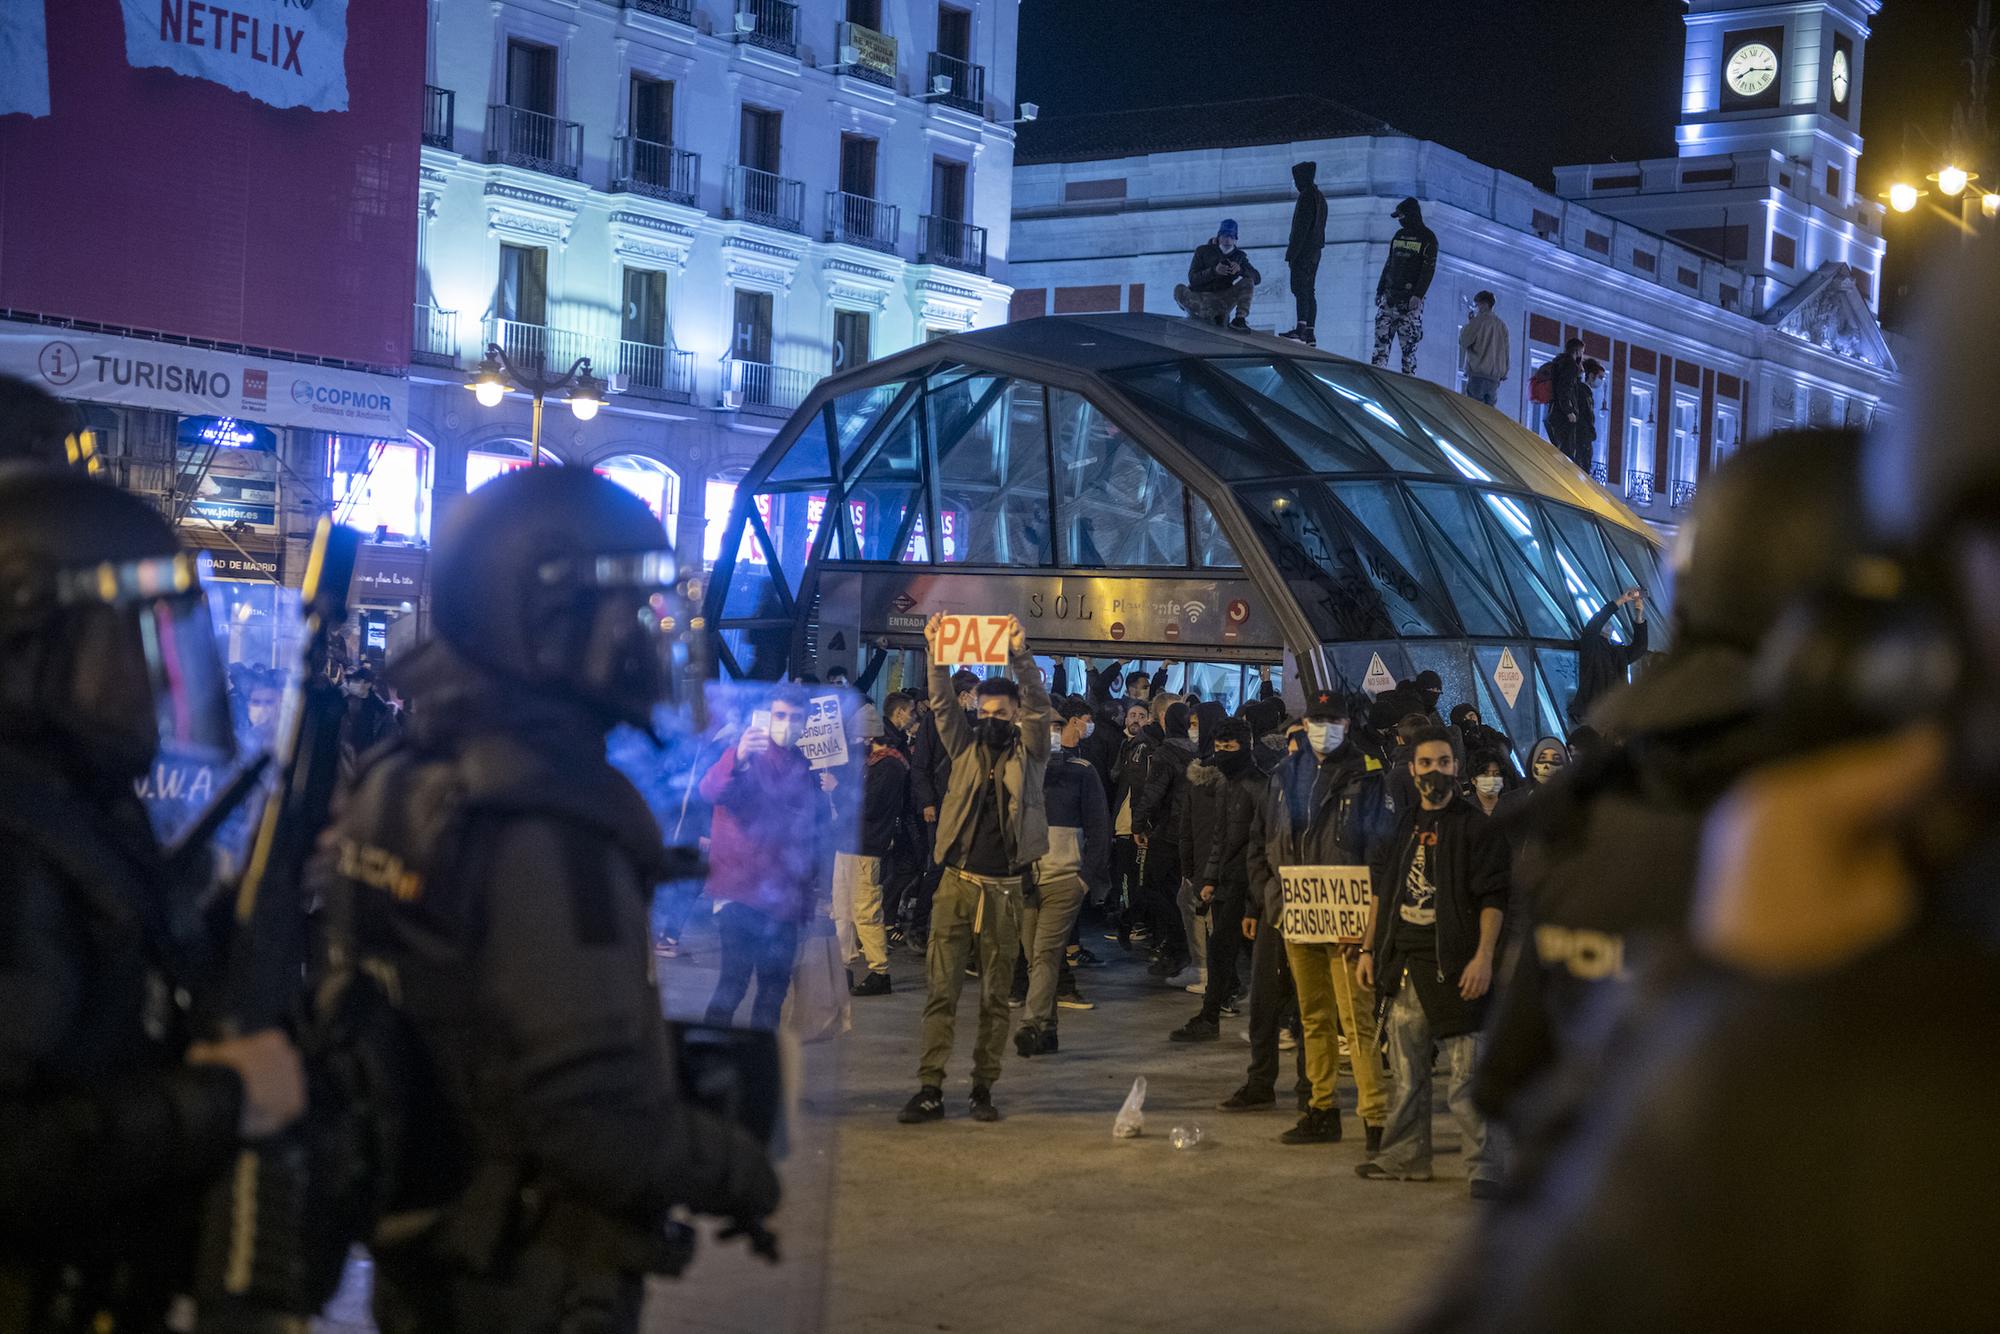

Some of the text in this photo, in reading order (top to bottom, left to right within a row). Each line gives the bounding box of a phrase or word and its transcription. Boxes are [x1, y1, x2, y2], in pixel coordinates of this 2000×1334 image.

[160, 0, 305, 77] NETFLIX
[92, 355, 231, 399] TURISMO
[316, 386, 391, 411] COPMOR
[190, 507, 259, 520] www.jolfer.es
[229, 560, 242, 570] DE
[1029, 592, 1093, 620] SOL
[889, 616, 925, 628] ENTRADA
[937, 617, 1010, 663] PAZ
[1498, 671, 1520, 681] PELIGRO
[1282, 878, 1371, 905] BASTA YA DE
[1285, 909, 1339, 936] CENSURA
